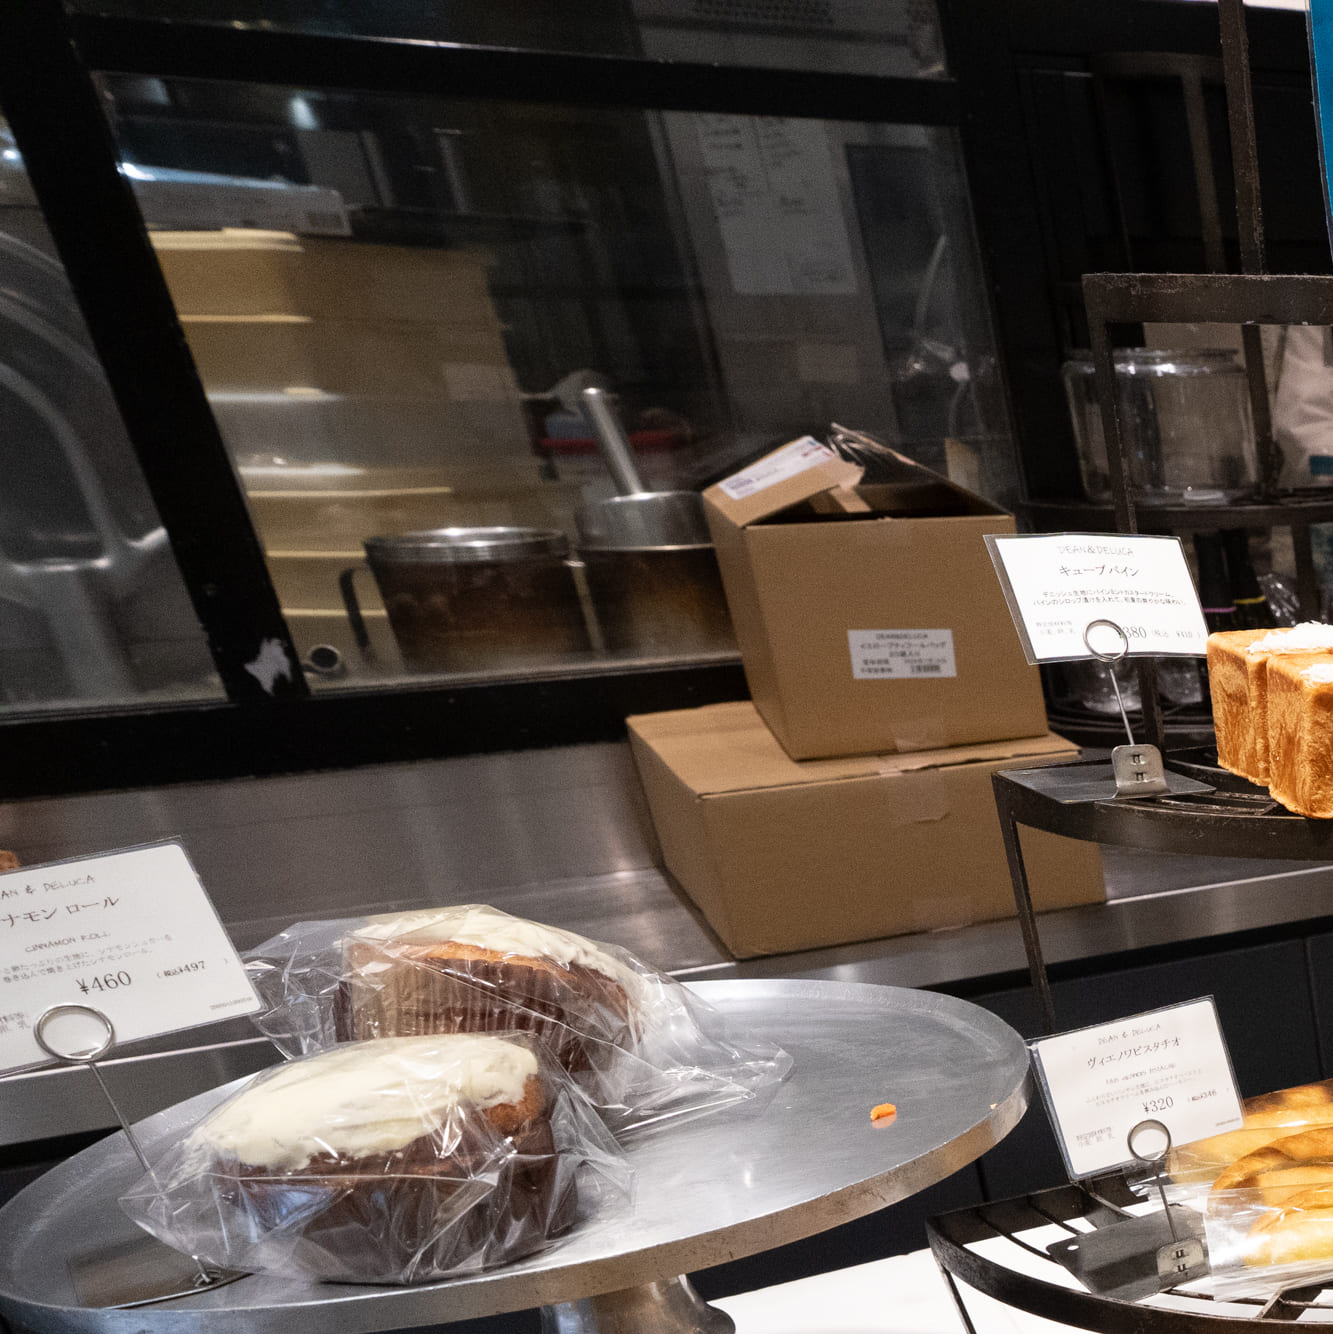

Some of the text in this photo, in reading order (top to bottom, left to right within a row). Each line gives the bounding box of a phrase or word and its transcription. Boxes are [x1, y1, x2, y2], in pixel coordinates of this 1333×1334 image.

[25, 884, 35, 894] &
[43, 875, 95, 893] DELUCA
[66, 896, 119, 914] ロール
[25, 937, 76, 953] CINNAMON
[75, 970, 132, 995] ¥460
[1088, 1036, 1182, 1069] ヴィエノワピスタチオ
[1142, 1096, 1174, 1114] ¥320
